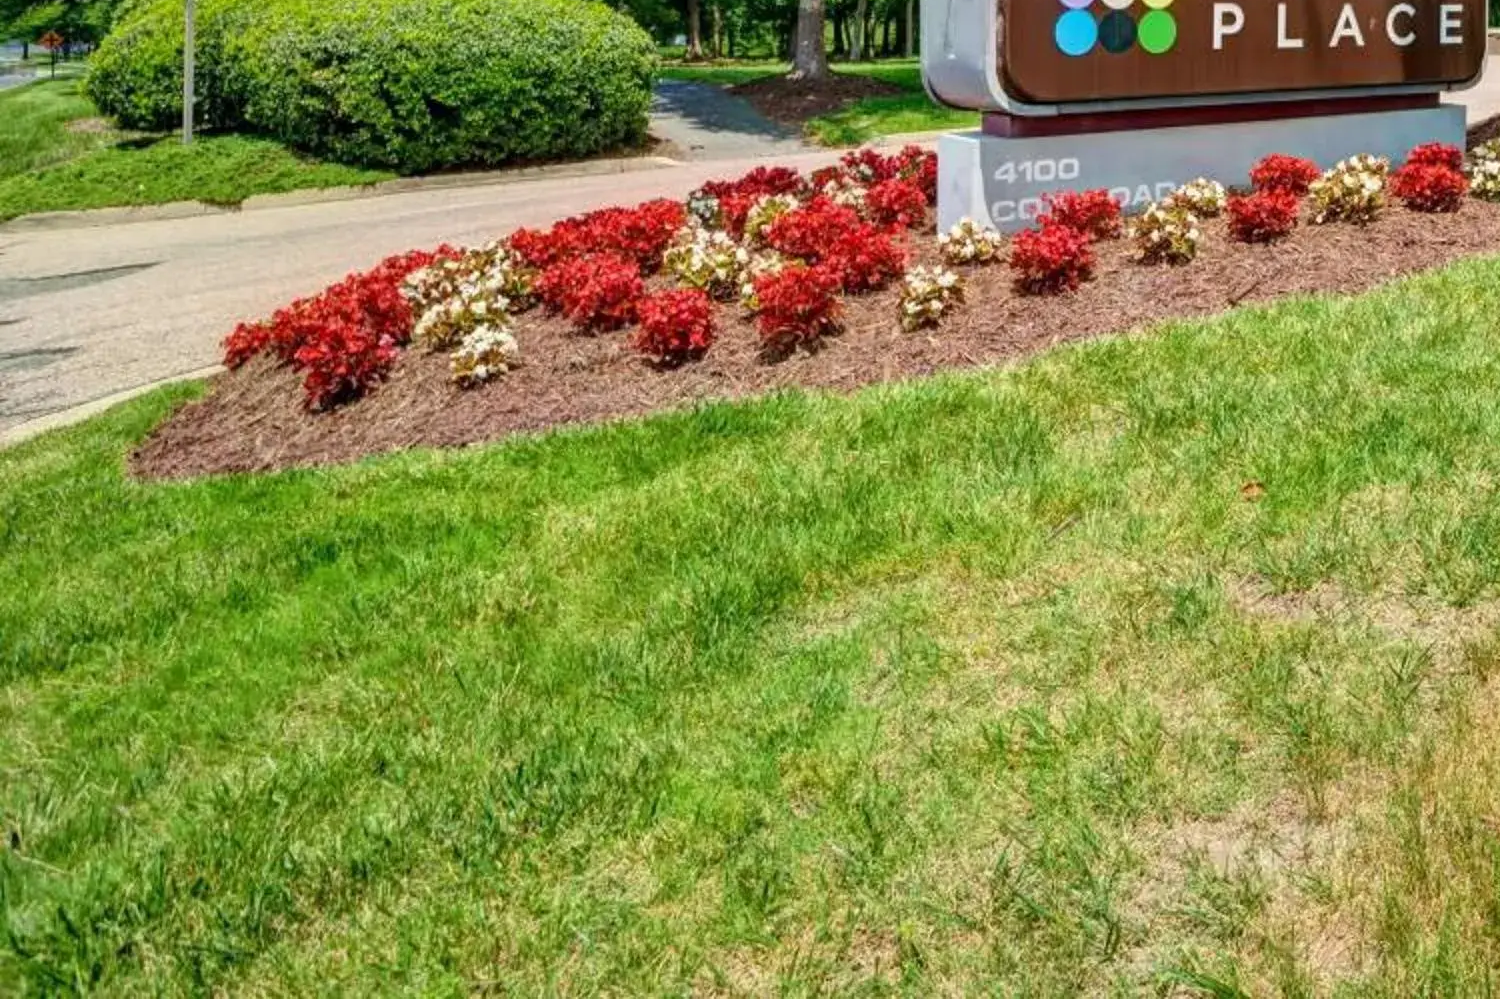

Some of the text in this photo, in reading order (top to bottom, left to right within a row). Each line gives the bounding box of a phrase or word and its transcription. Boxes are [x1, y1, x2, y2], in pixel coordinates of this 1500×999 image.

[1212, 2, 1465, 50] PLACE
[994, 157, 1080, 184] 4100
[991, 181, 1176, 222] CO OAD
